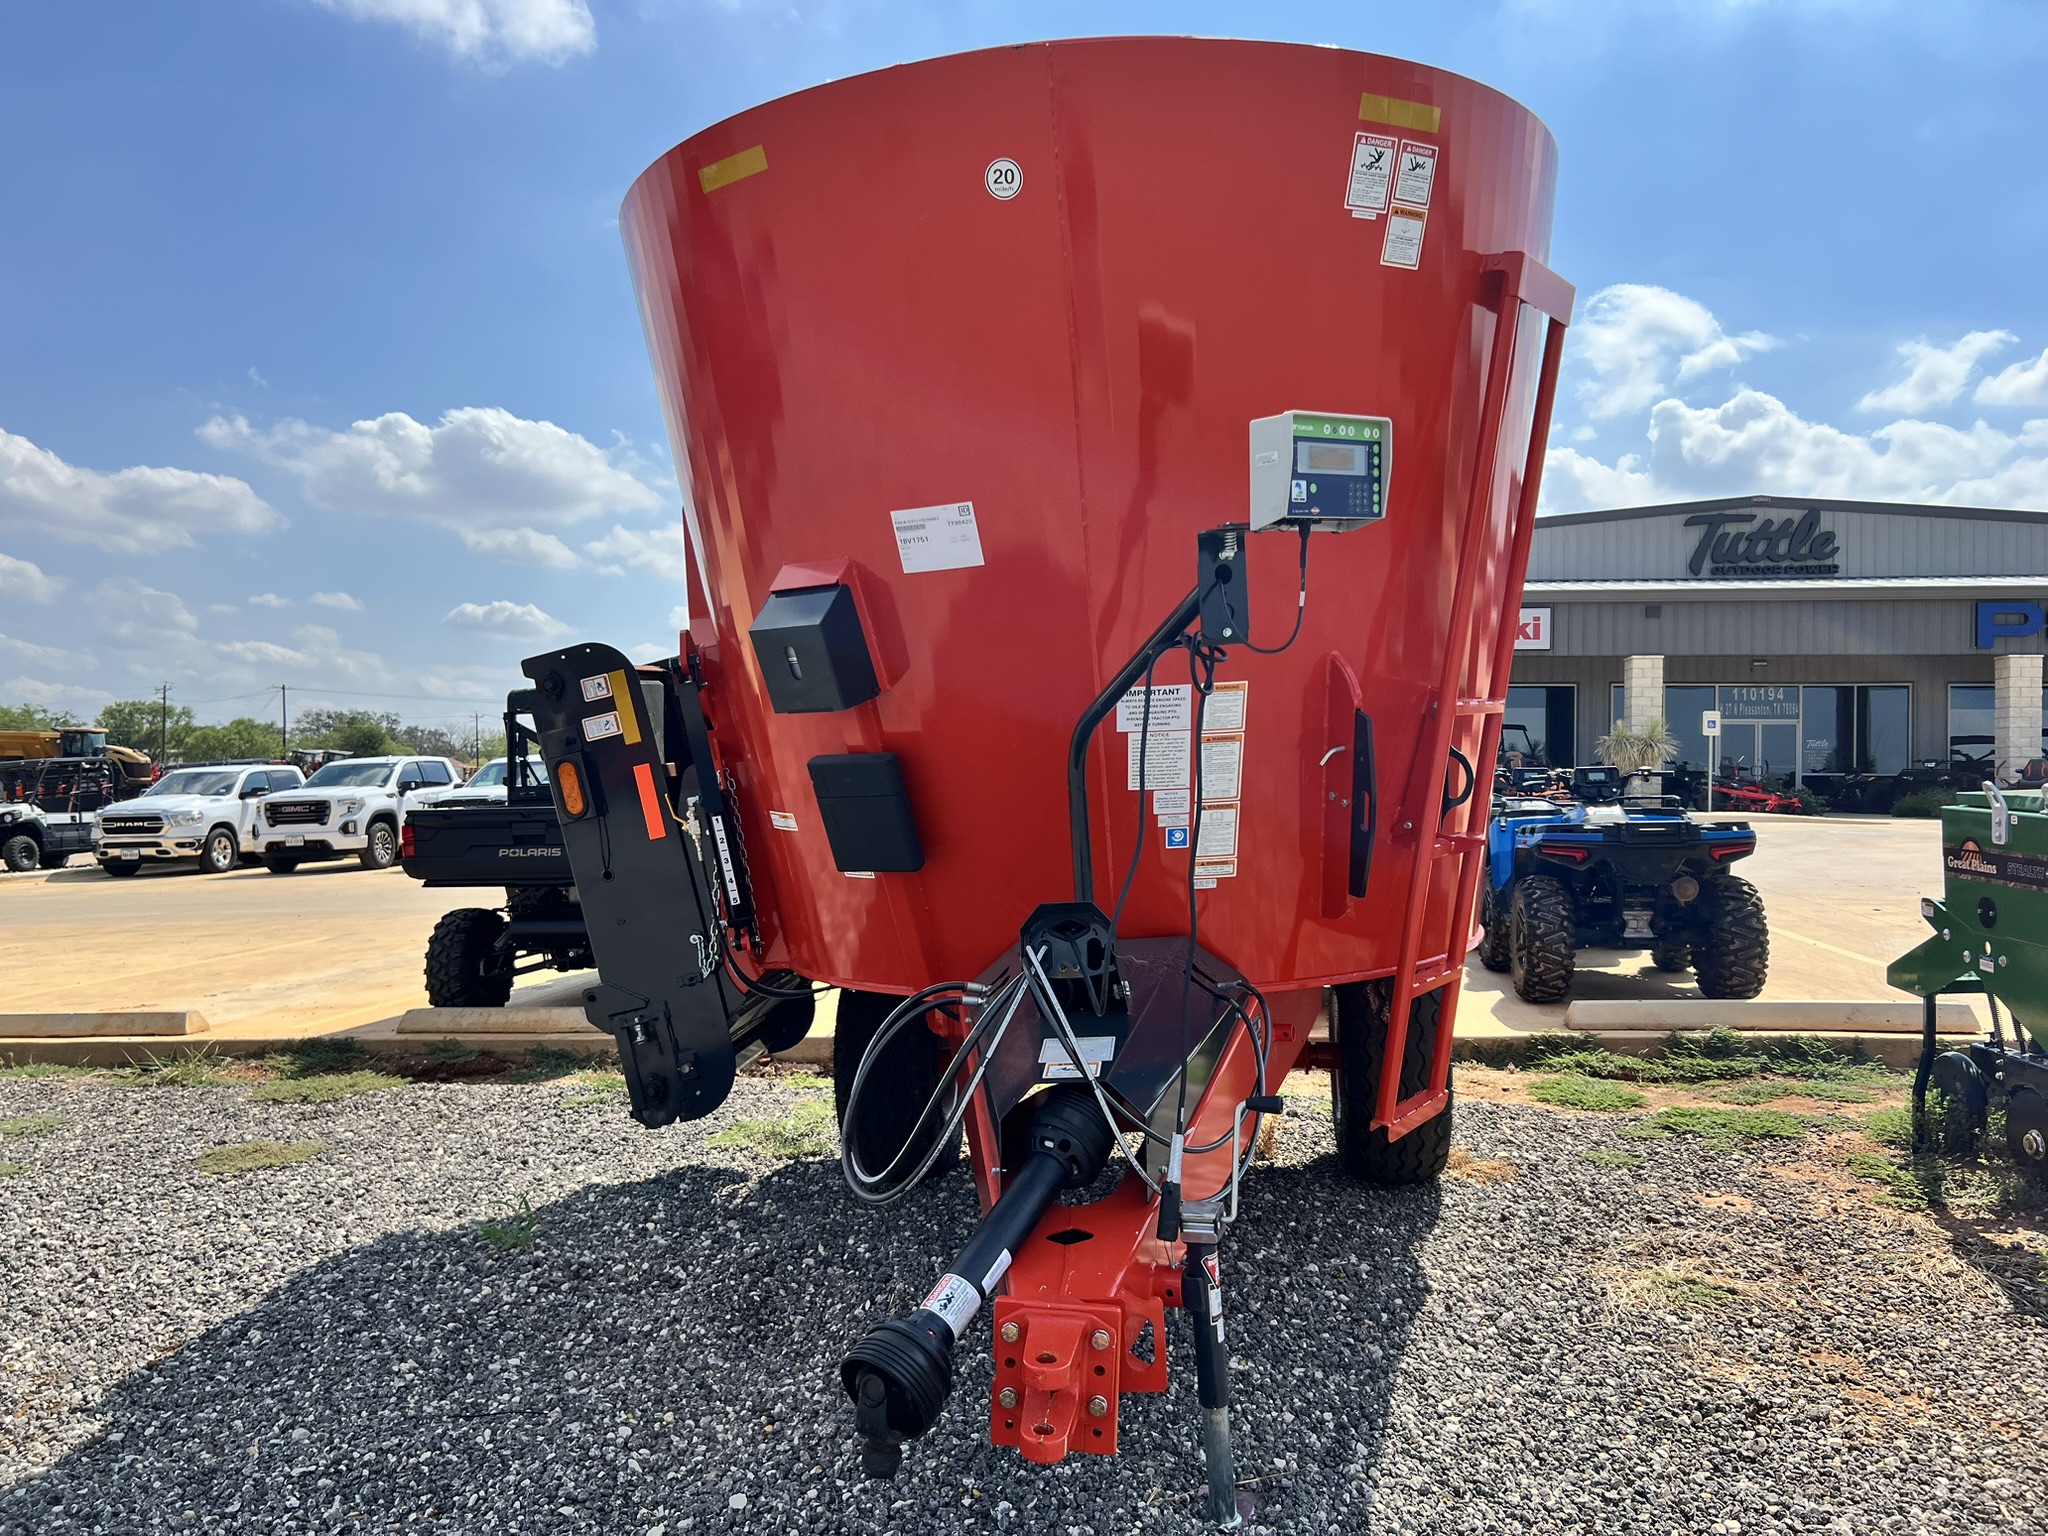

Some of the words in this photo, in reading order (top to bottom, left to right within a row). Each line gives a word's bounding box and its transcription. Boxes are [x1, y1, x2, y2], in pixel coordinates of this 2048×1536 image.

[1367, 137, 1392, 147] DANGER
[1412, 147, 1432, 155] DANGER
[993, 169, 1014, 184] 20
[1400, 209, 1422, 219] WARNING
[1683, 508, 1840, 576] Tuttle
[1711, 565, 1782, 575] OUTDOOR
[1784, 564, 1840, 574] POWER
[1515, 616, 1541, 640] ki
[1975, 602, 2048, 649] P
[1732, 688, 1784, 700] 110194
[1740, 703, 1771, 716] Pleasanton,
[1774, 703, 1780, 715] TX
[1806, 739, 1828, 749] Tuttle
[498, 848, 561, 857] POLARIS
[1948, 856, 1970, 870] Great
[1972, 860, 1997, 874] Plains
[2007, 862, 2044, 879] STEALTH
[929, 1275, 954, 1303] DANGER
